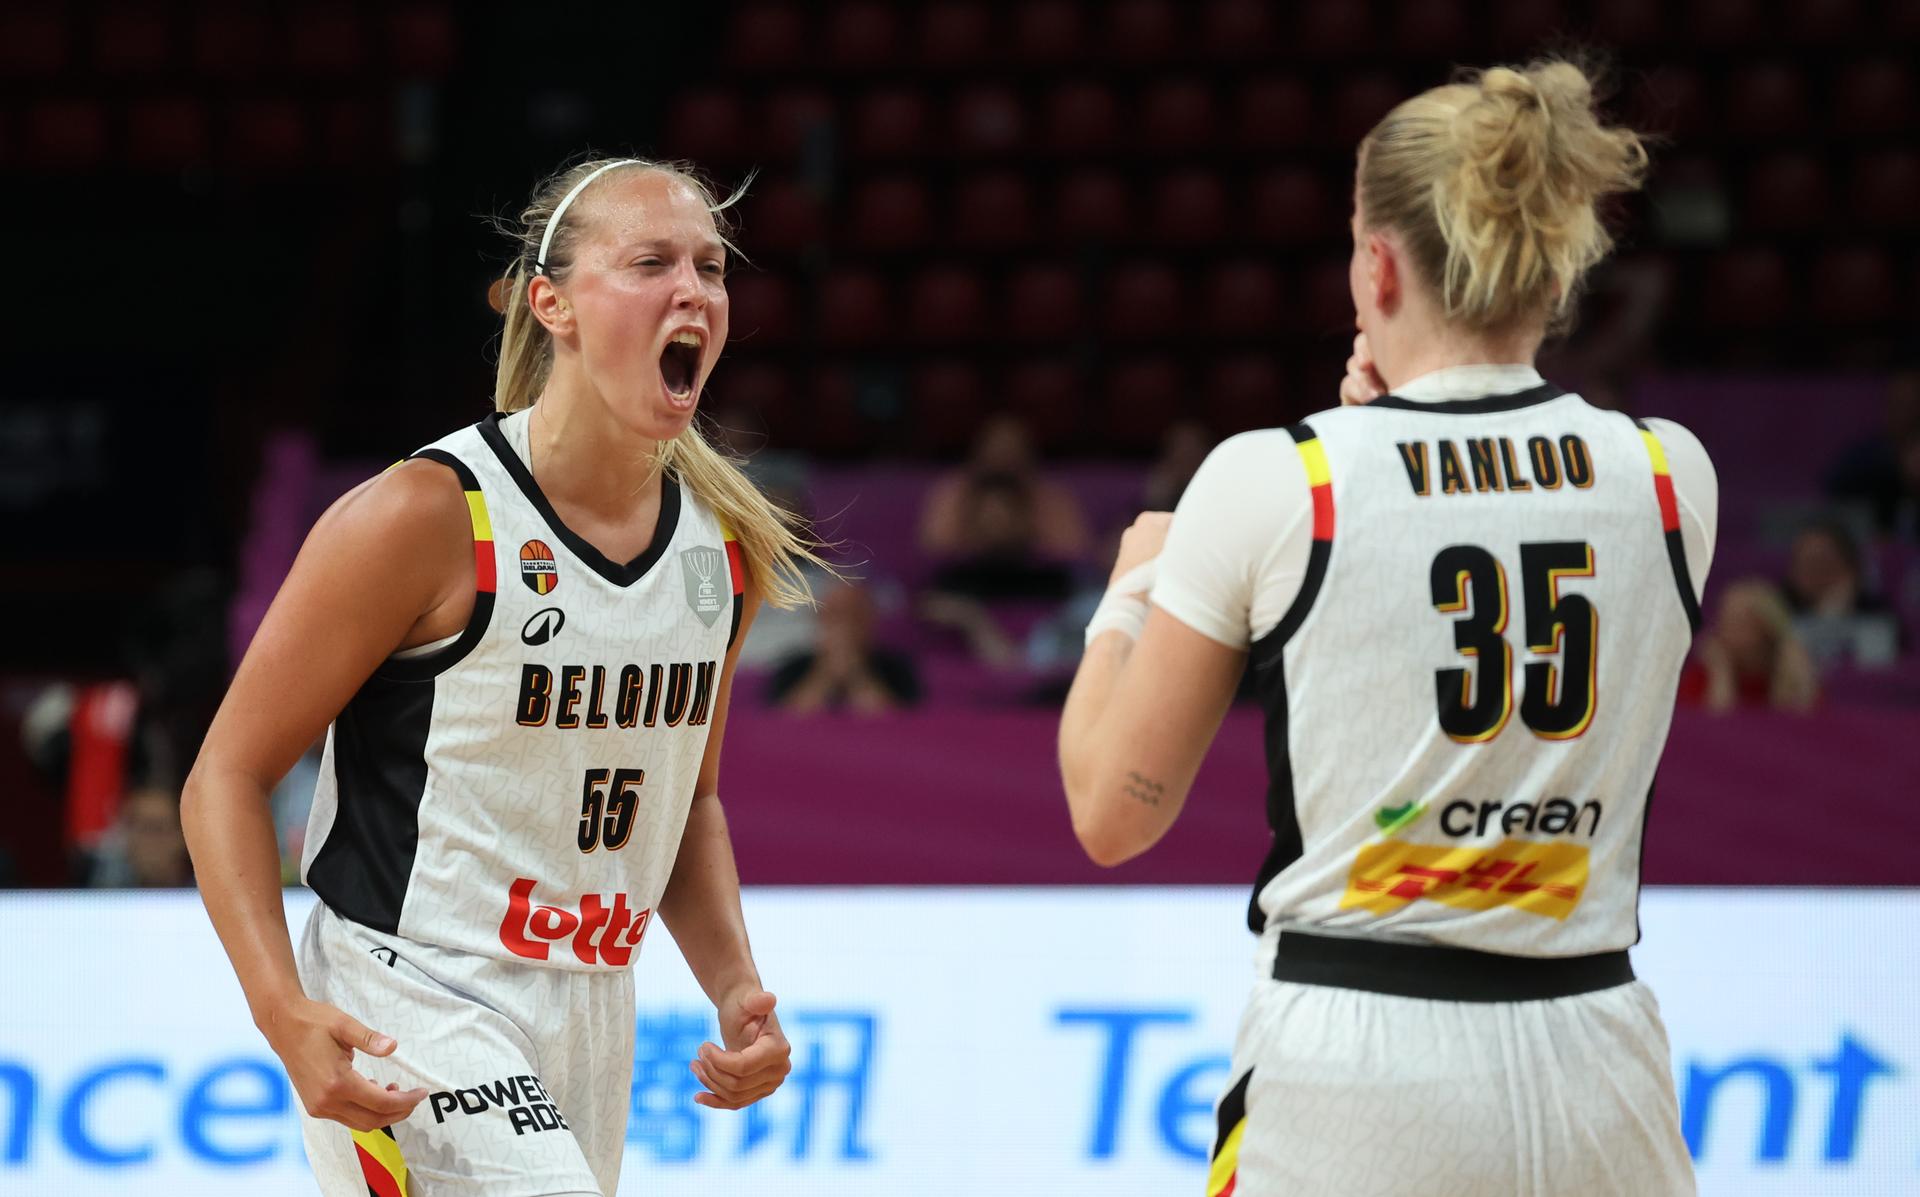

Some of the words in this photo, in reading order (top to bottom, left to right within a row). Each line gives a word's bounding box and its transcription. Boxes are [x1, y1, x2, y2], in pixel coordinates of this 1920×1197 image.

[1396, 434, 1595, 497] VANLOO
[1430, 540, 1598, 744] 35
[515, 660, 717, 730] BELGIUM
[577, 768, 645, 854] 55
[499, 877, 651, 966] Lotto
